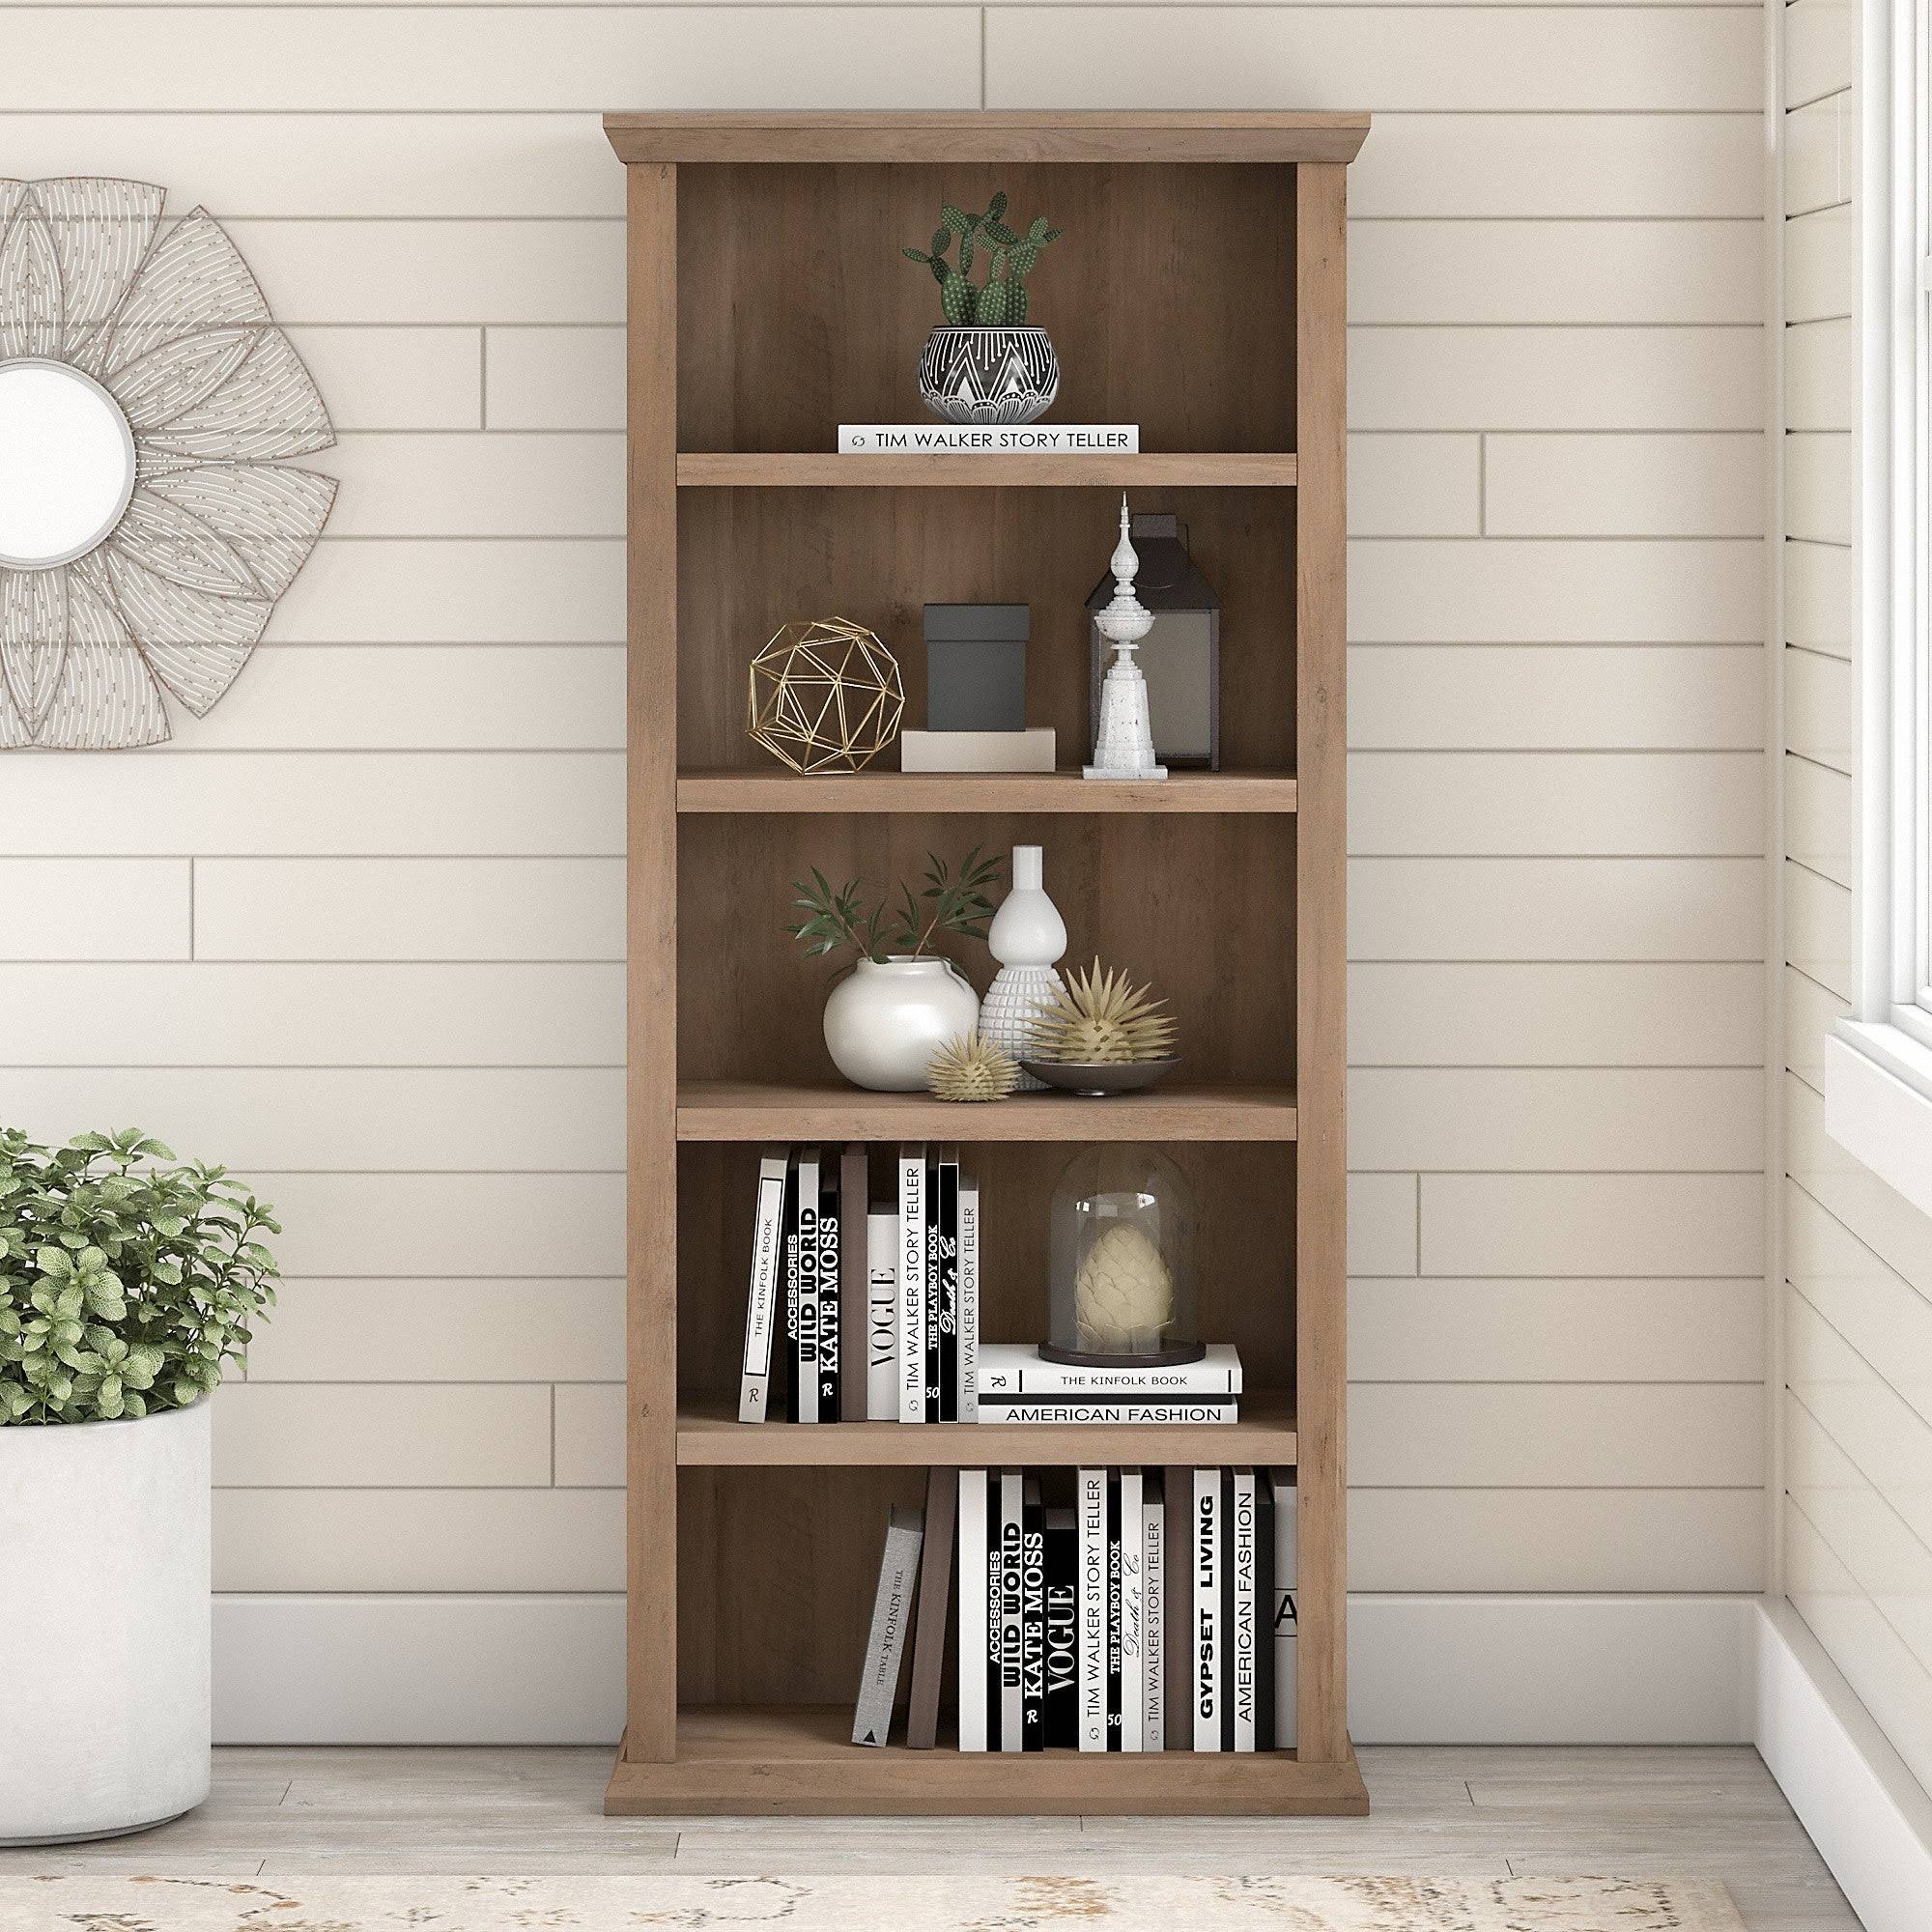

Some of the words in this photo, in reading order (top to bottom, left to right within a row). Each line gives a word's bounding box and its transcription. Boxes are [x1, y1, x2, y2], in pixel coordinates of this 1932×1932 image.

[876, 433, 907, 447] TIM
[915, 433, 993, 447] WALKER
[1000, 433, 1060, 447] STORY
[1066, 433, 1128, 447] TELLER
[907, 1168, 919, 1222] TELLER
[762, 1218, 773, 1253] BOOK
[801, 1208, 817, 1294] WORLD
[820, 1217, 838, 1293] MOSS
[907, 1228, 919, 1283] STORY
[928, 1225, 938, 1263] BOOK
[964, 1208, 974, 1254] TELLER
[758, 1257, 769, 1309] KINFOLK
[787, 1234, 798, 1340] ACCESSORIES
[928, 1264, 938, 1323] PLAYBOY
[964, 1259, 974, 1303] STORY
[755, 1314, 764, 1337] THE
[801, 1303, 817, 1362] WILD
[820, 1300, 838, 1373] KATE
[870, 1267, 895, 1367] VOGUE
[907, 1288, 919, 1356] WALKER
[928, 1325, 938, 1350] THE
[964, 1308, 974, 1366] WALKER
[907, 1362, 919, 1390] TIM
[964, 1371, 974, 1394] TIM
[1061, 1377, 1087, 1385] THE
[1091, 1377, 1147, 1385] KINFOLK
[1151, 1377, 1187, 1385] BOOK
[1006, 1408, 1120, 1421] AMERICAN
[1128, 1408, 1221, 1421] FASHION
[1088, 1479, 1099, 1538] TELLER
[1003, 1522, 1021, 1615] WORLD
[1111, 1541, 1121, 1581] BOOK
[1149, 1522, 1159, 1572] TELLER
[1200, 1495, 1213, 1587] LIVING
[1238, 1492, 1252, 1591] FASHION
[893, 1570, 904, 1590] THE
[1024, 1532, 1043, 1613] MOSS
[1088, 1544, 1099, 1602] STORY
[1149, 1577, 1159, 1625] STORY
[883, 1594, 901, 1652] KINFOLK
[989, 1550, 1001, 1663] ACCESSORIES
[1111, 1583, 1121, 1646] PLAYBOY
[1122, 1598, 1140, 1658] Death
[1003, 1624, 1021, 1687] WILD
[1024, 1621, 1043, 1699] KATE
[1047, 1585, 1074, 1694] VOGUE
[1088, 1607, 1099, 1681] WALKER
[1111, 1648, 1121, 1674] THE
[1149, 1630, 1159, 1690] WALKER
[1200, 1608, 1213, 1719] GYPSET
[1238, 1601, 1252, 1722] AMERICAN
[877, 1654, 893, 1686] TABLE
[1088, 1687, 1099, 1718] TIM
[1149, 1696, 1159, 1721] TIM
